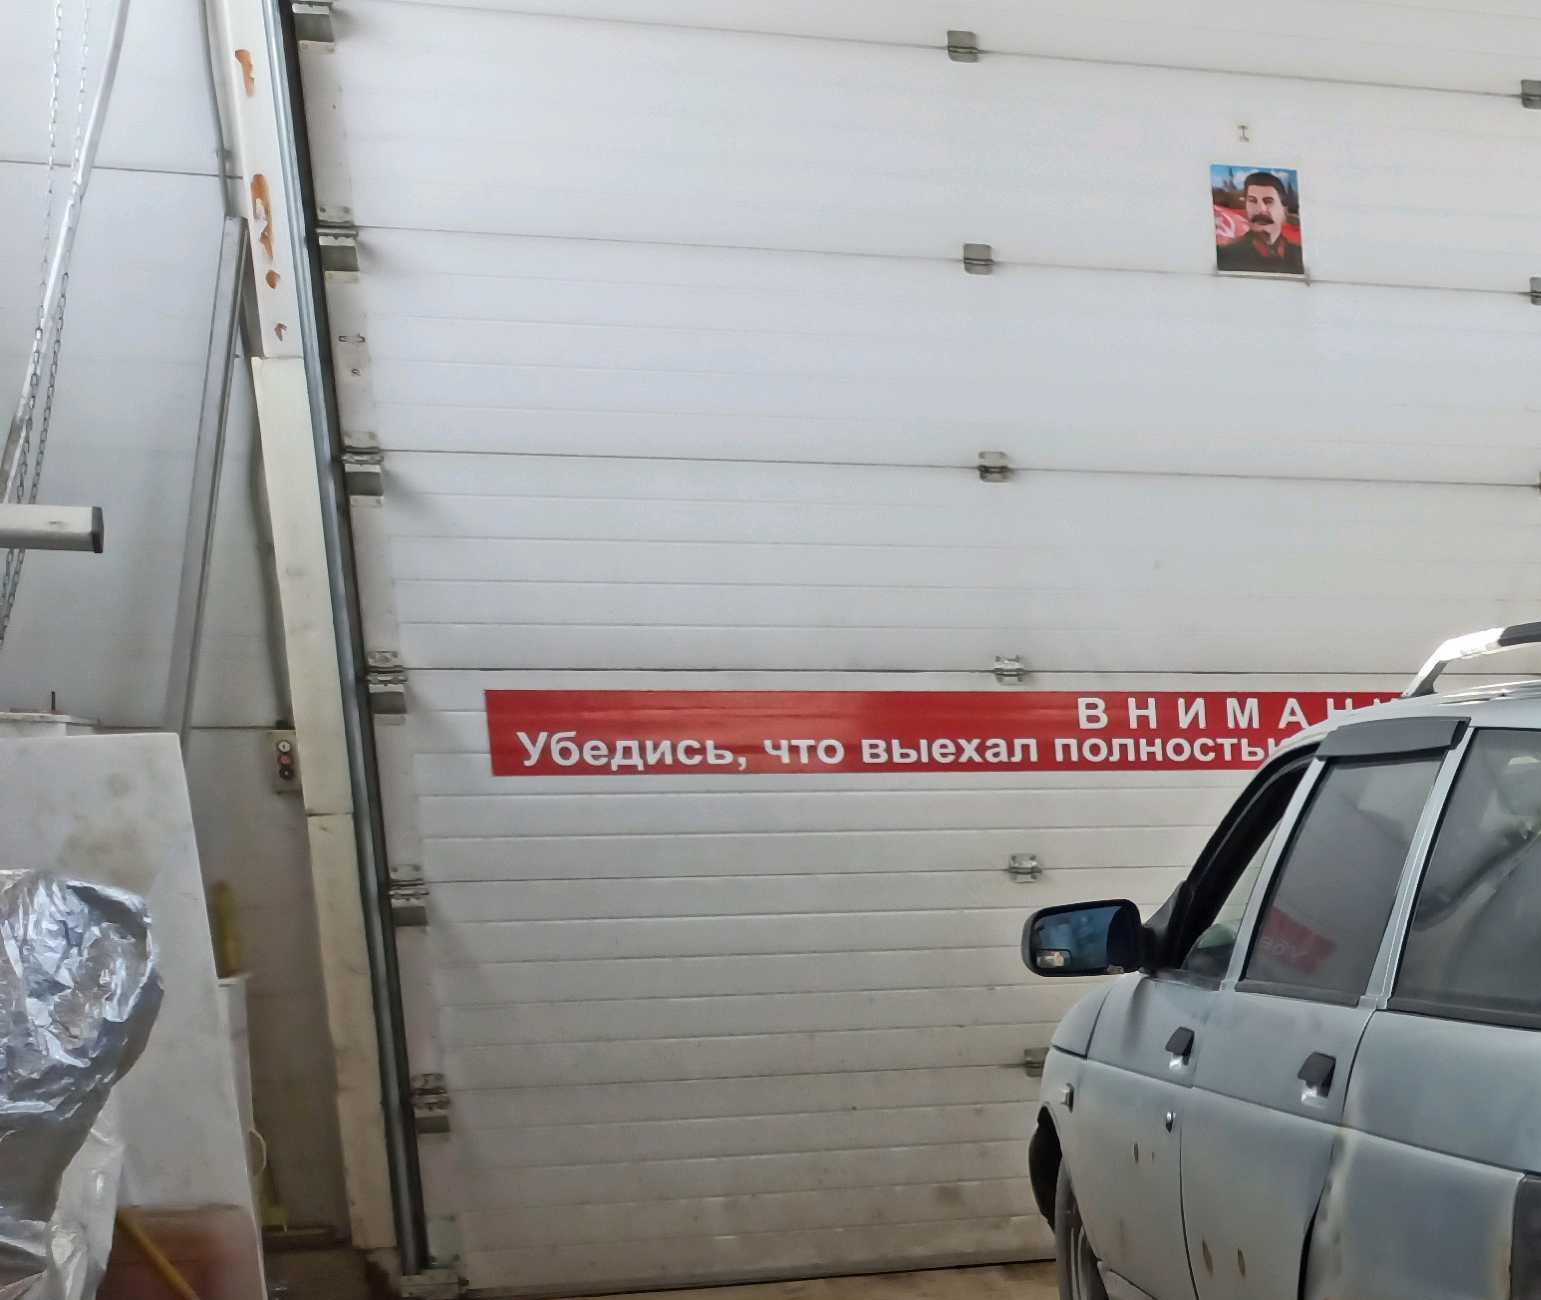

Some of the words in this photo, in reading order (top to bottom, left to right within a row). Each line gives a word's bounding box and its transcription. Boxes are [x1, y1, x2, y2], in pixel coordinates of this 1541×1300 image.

[1077, 697, 1397, 730] ВНИМА
[516, 730, 749, 772] Убедись,
[764, 737, 846, 765] что
[862, 737, 1038, 764] выехал
